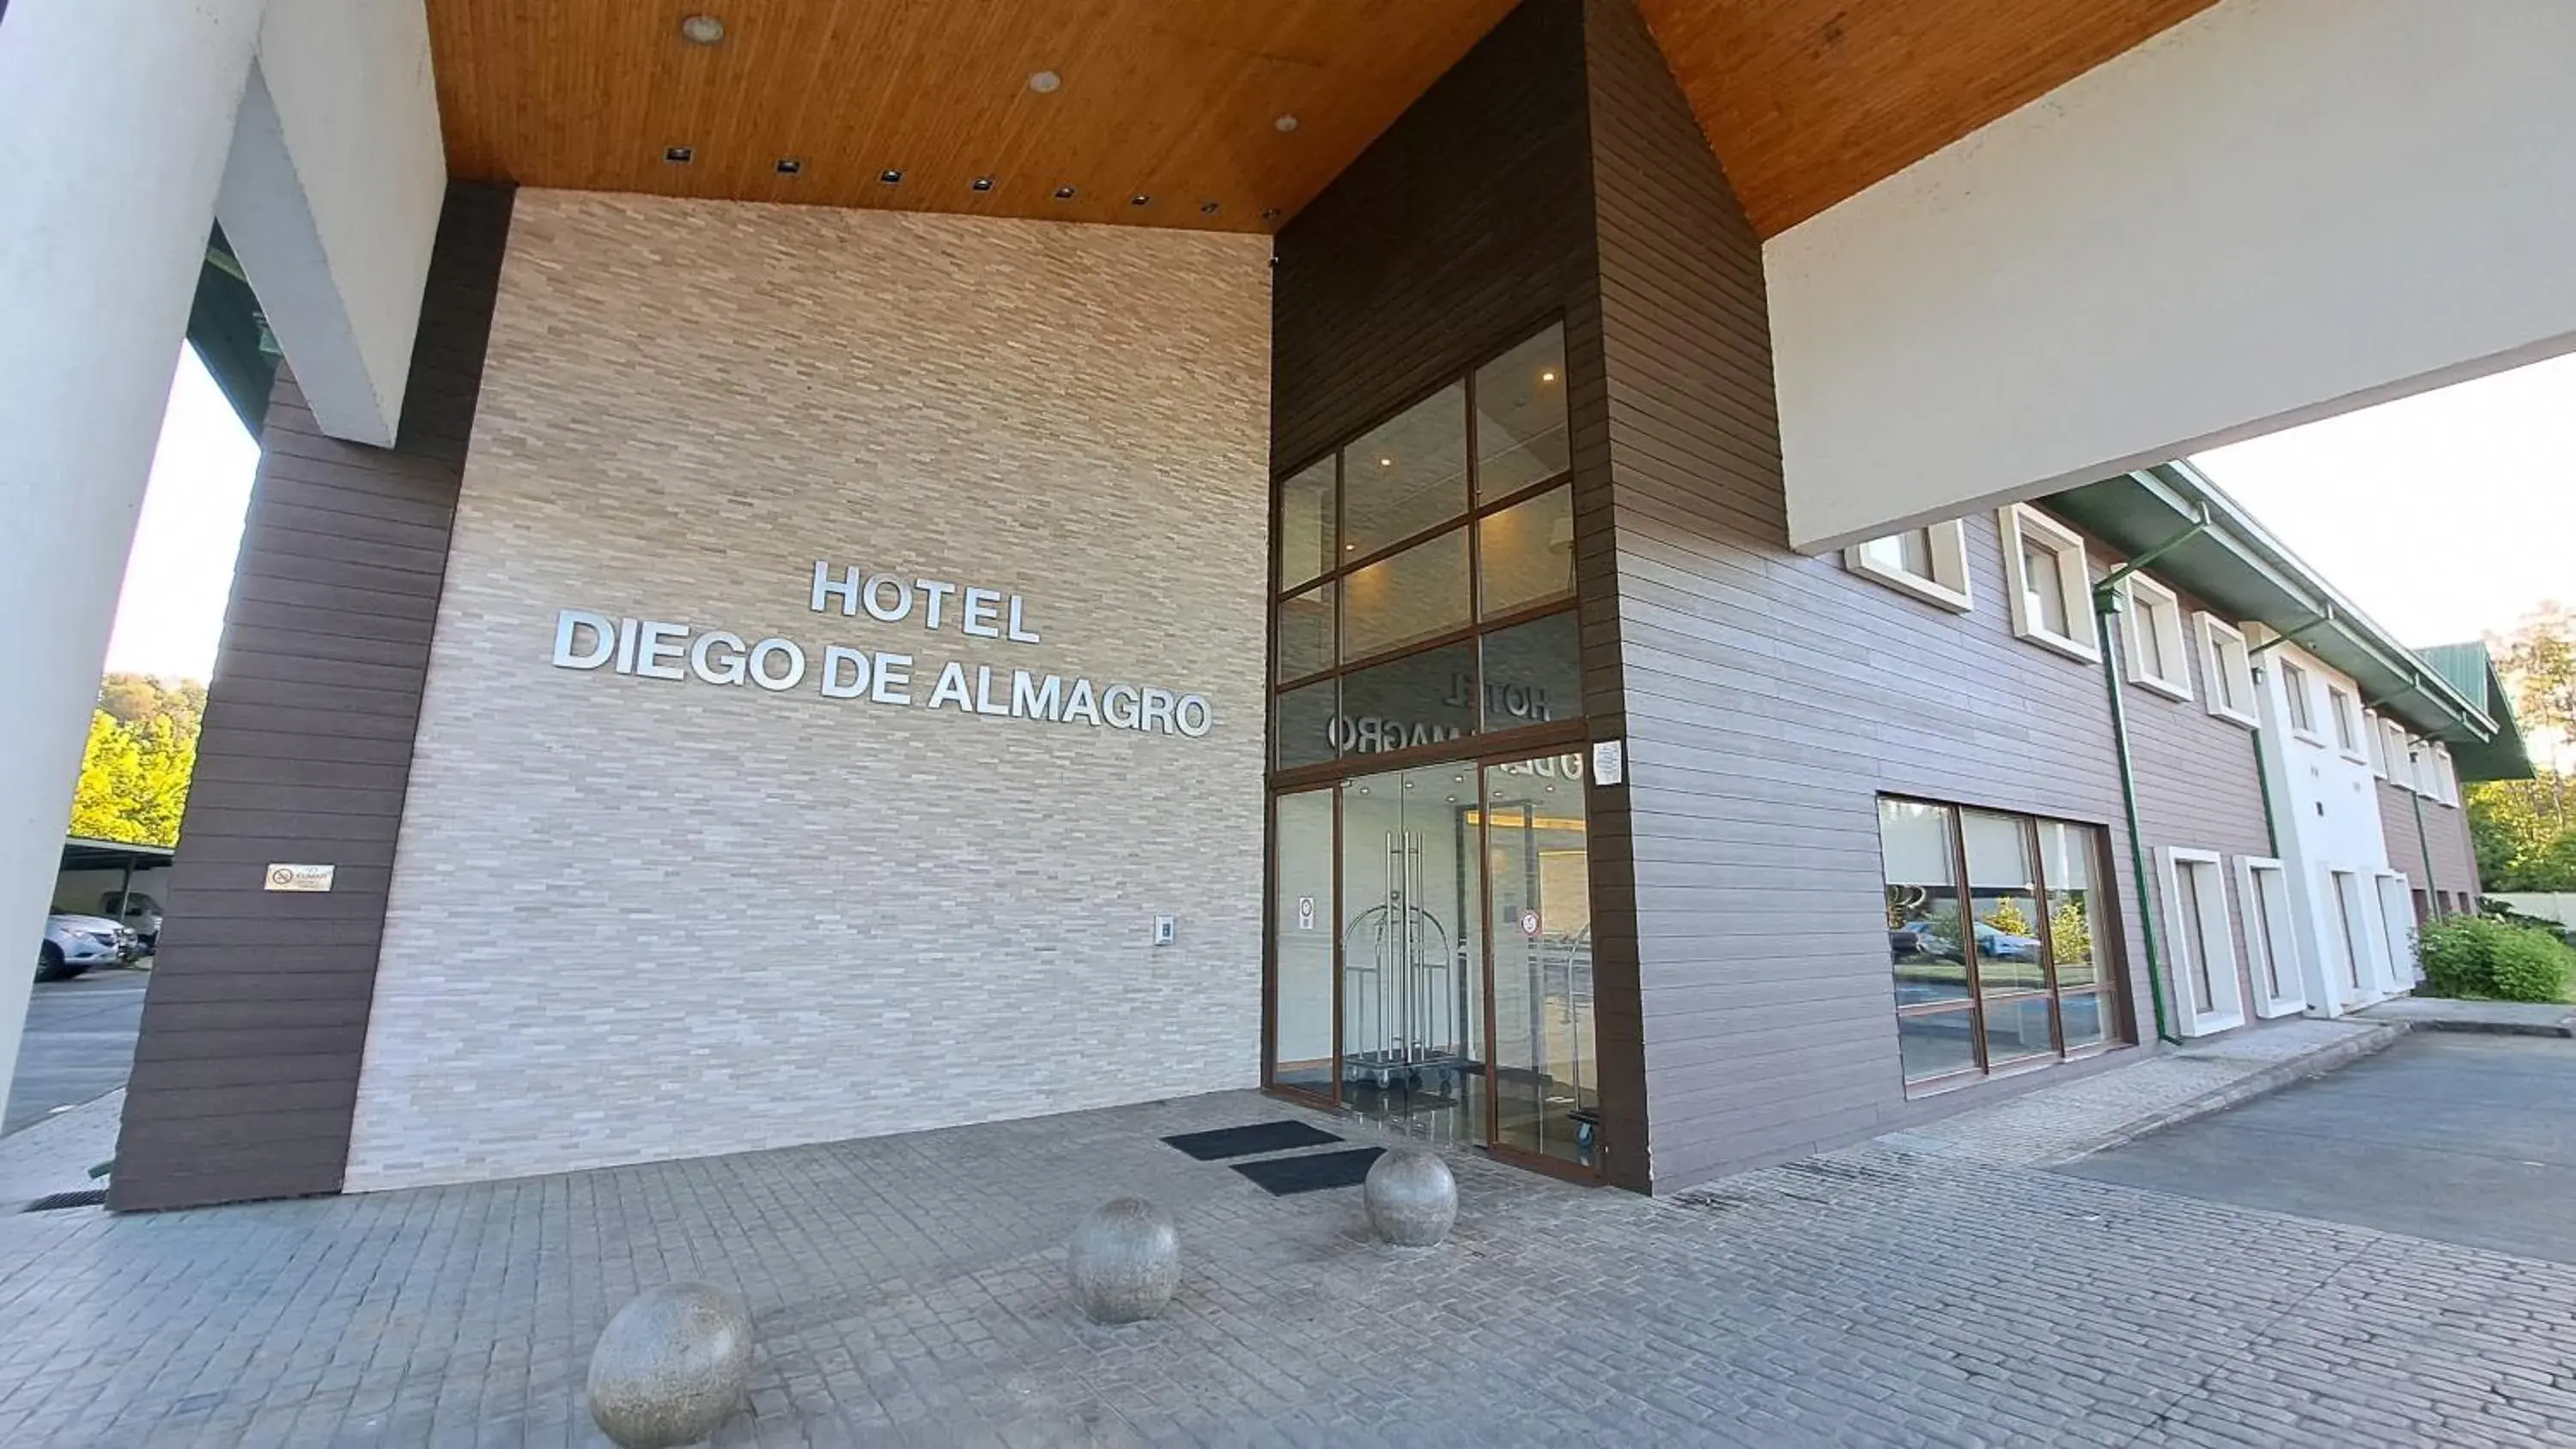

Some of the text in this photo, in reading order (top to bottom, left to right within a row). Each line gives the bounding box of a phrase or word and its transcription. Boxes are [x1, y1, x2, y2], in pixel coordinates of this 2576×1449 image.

[811, 560, 1040, 643] HOTEL
[552, 609, 1212, 737] DIEGO DE ALMAGRO
